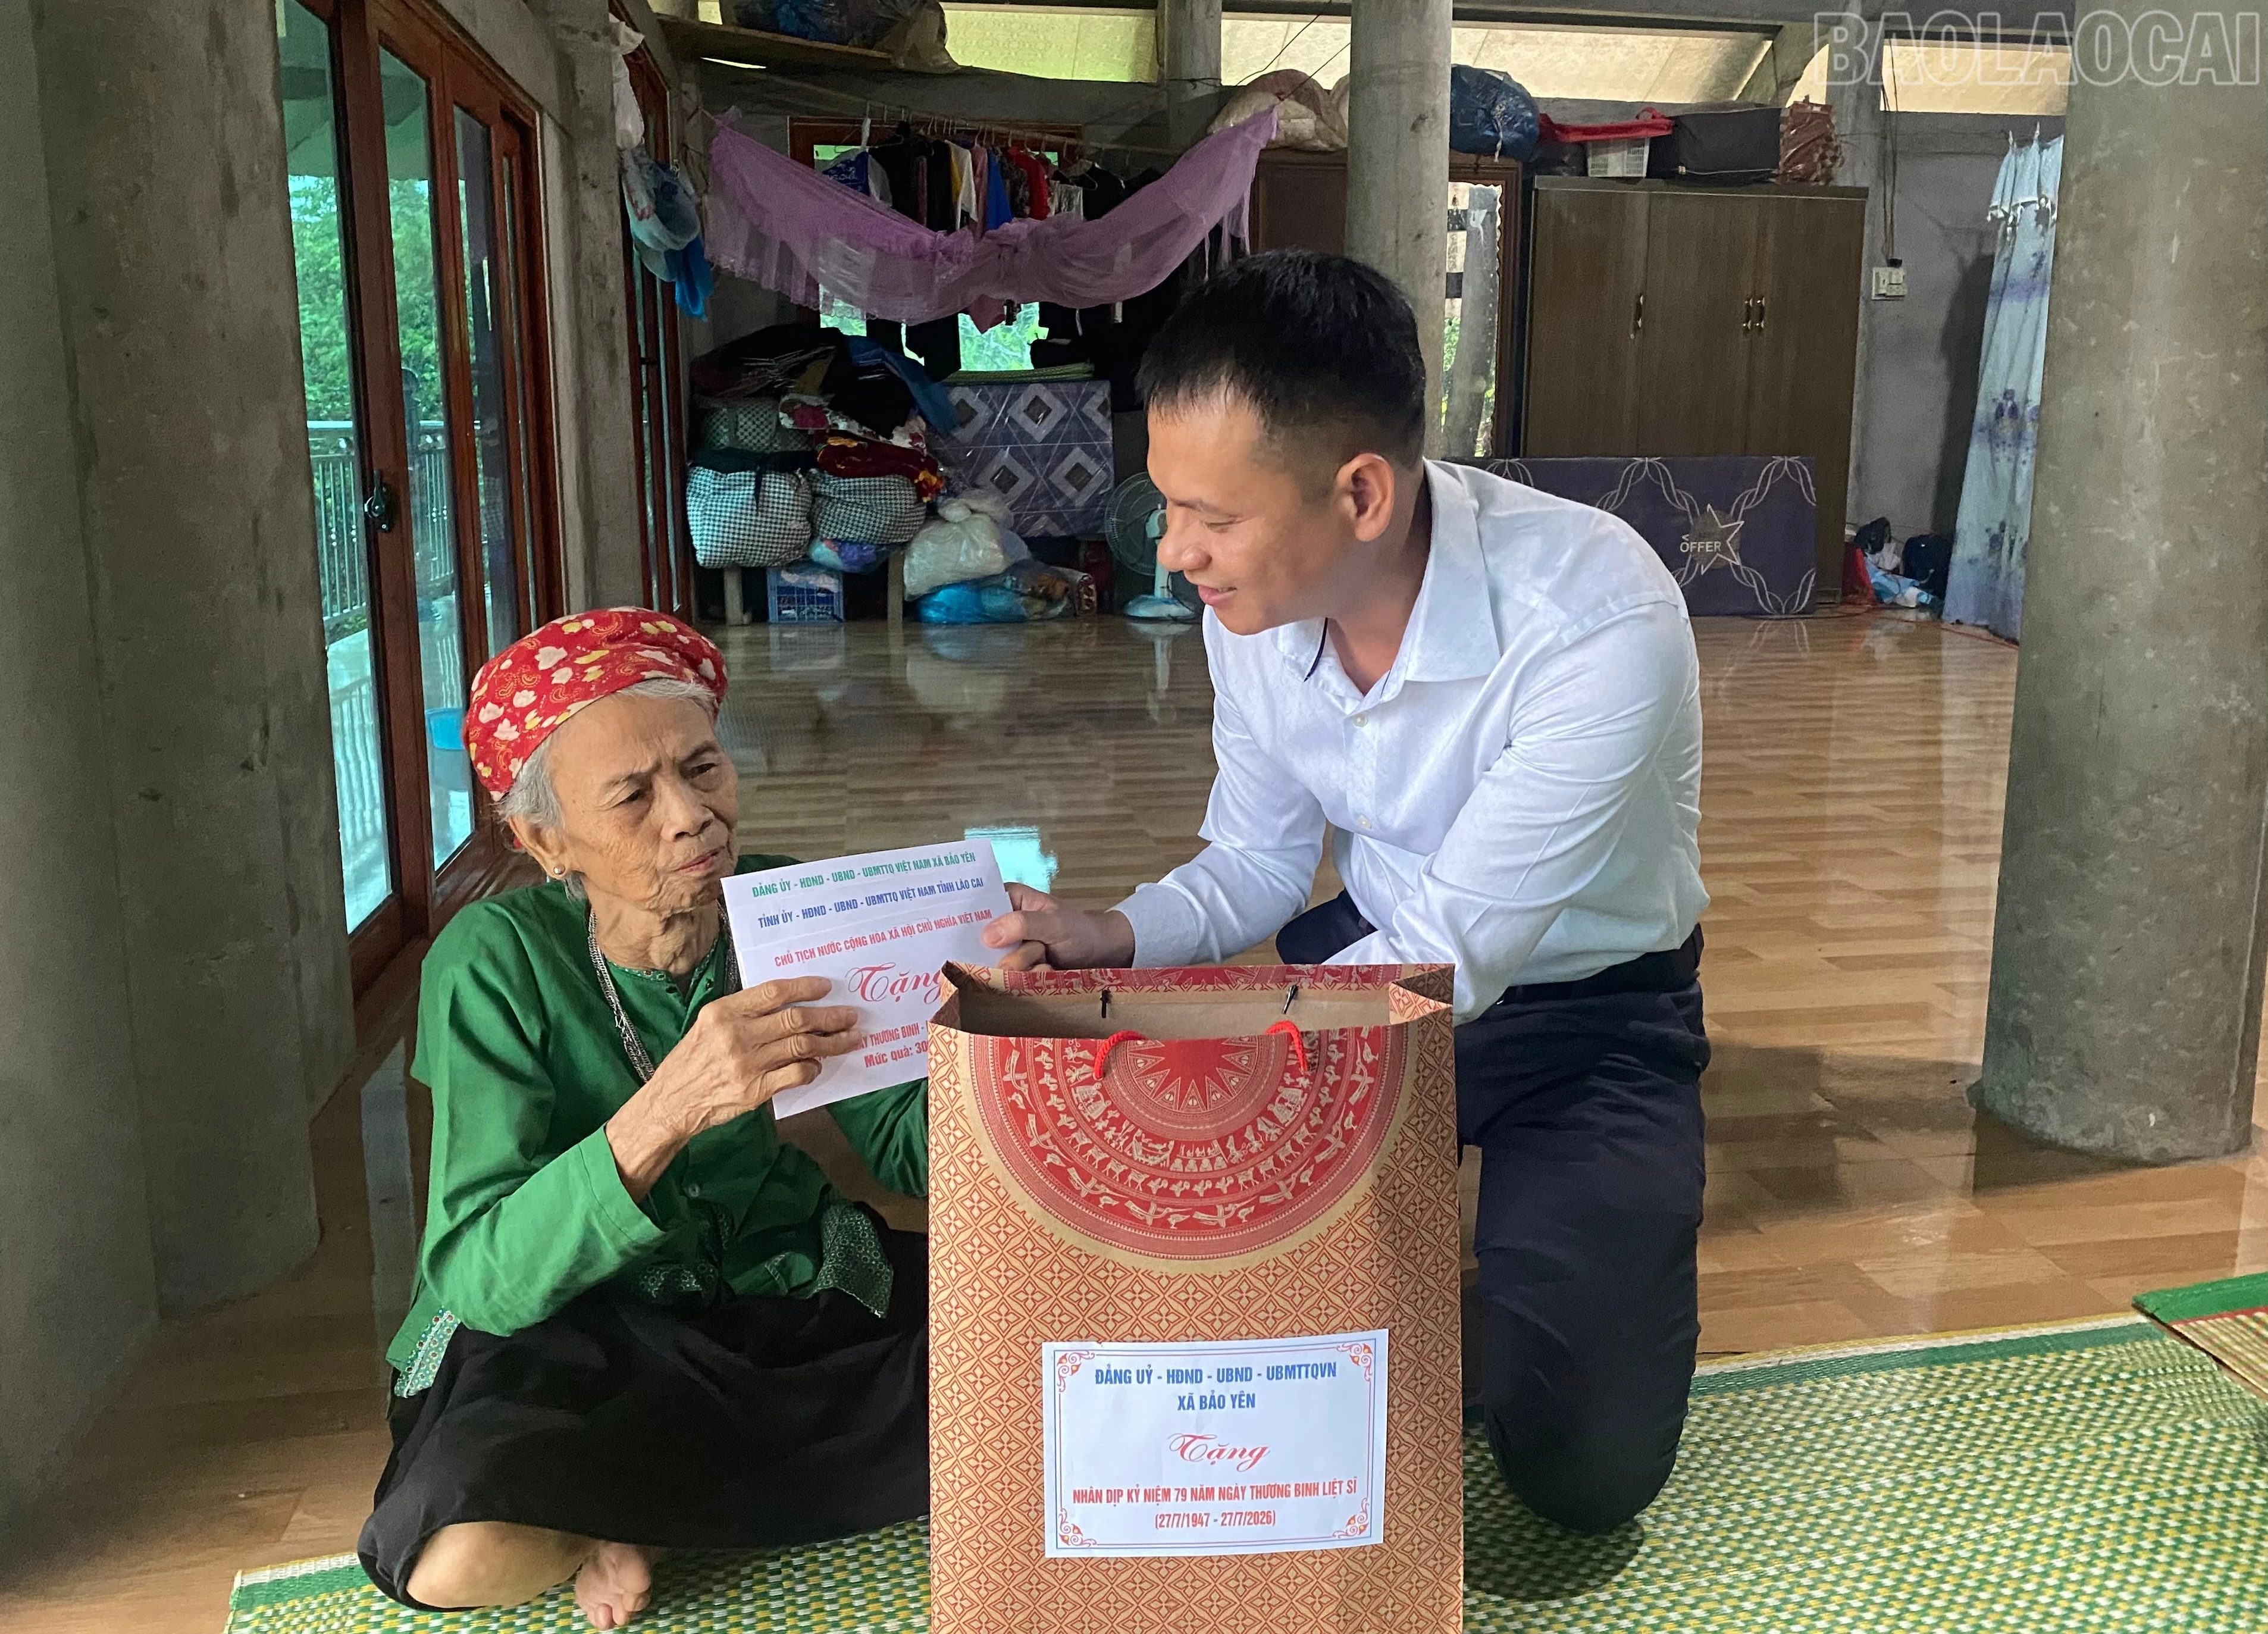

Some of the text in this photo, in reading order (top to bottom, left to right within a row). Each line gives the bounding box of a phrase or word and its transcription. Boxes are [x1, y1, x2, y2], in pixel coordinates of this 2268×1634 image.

[1680, 541, 1721, 553] OFFER
[752, 882, 778, 897] ĐẢNG
[780, 878, 791, 891] ỦY
[832, 870, 856, 882] UBND
[862, 865, 894, 878] UBMTTQ
[895, 860, 912, 874] VIỆT
[913, 859, 932, 870] NAM
[932, 855, 944, 867] XÃ
[944, 852, 960, 865] BẢO
[960, 852, 976, 863] YÊN
[758, 913, 780, 928] TỈNH
[782, 909, 792, 923] ỦY
[802, 905, 826, 919] HĐND
[834, 899, 858, 912] UBND
[865, 891, 898, 906] UBMTTQ
[899, 887, 916, 900] VIỆT
[917, 885, 936, 897] NAM
[937, 880, 955, 893] TỈNH
[956, 878, 970, 891] LÀO
[970, 878, 983, 887] CAI
[775, 950, 794, 967] CHỦ
[795, 948, 816, 963] TỊCH
[817, 941, 842, 957] NƯỚC
[844, 936, 869, 951] CỘNG
[889, 927, 900, 940] XÃ
[901, 924, 916, 938] HỘI
[917, 921, 933, 933] CHỦ
[957, 912, 974, 925] VIỆT
[974, 909, 992, 921] NAM
[870, 1027, 900, 1046] THƯƠNG
[901, 1022, 920, 1038] BINH
[864, 1052, 888, 1068] Mức
[891, 1045, 913, 1062] quả:
[1095, 1364, 1132, 1384] ĐẢNG
[1136, 1364, 1153, 1384] UỶ
[1167, 1369, 1203, 1384] HĐND
[1217, 1367, 1253, 1383] UBND
[1266, 1361, 1336, 1381] UBMTTQVN
[1177, 1389, 1255, 1411] XÃ BẢO YÊN
[1167, 1433, 1271, 1472] Tặng
[1073, 1476, 1357, 1507] NHÂN DỊP KỶ NIỆM 79 NĂM NGÀY THƯƠNG BINH LIỆT SĨ
[1155, 1513, 1210, 1529] (27/7/1947
[1220, 1510, 1276, 1527] 27/7/2026)
